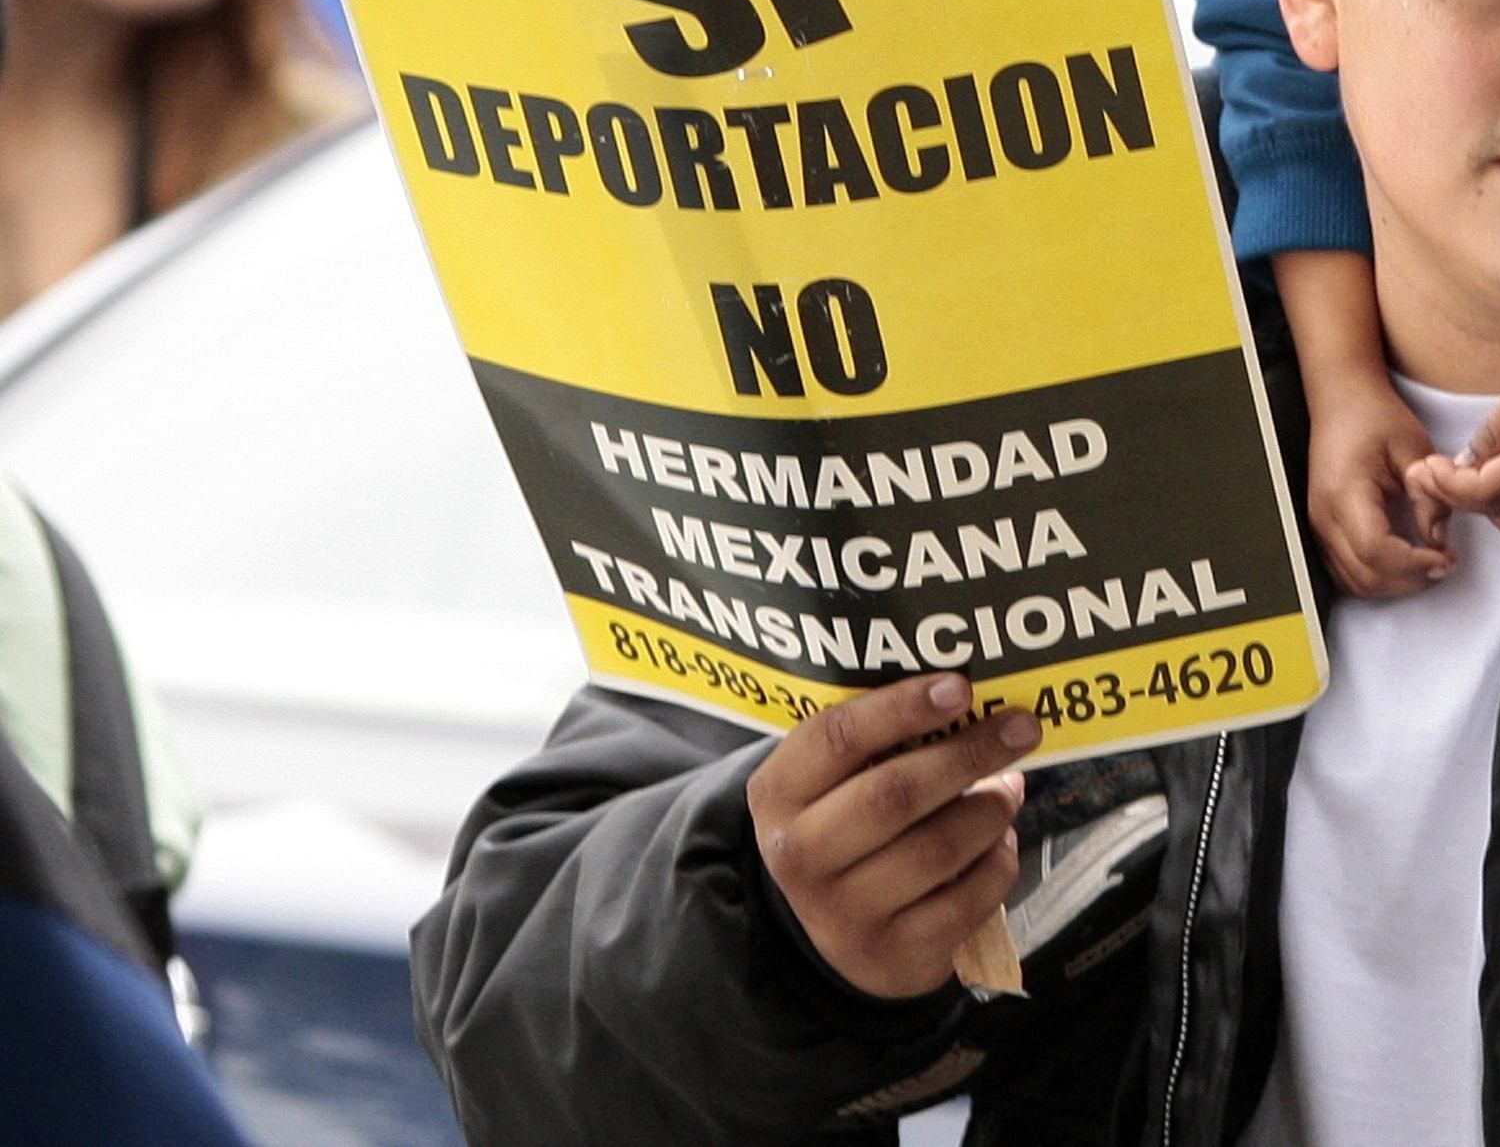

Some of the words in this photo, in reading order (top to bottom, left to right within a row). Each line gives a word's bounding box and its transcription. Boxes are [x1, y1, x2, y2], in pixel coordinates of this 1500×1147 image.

[399, 44, 1156, 212] DEPORTACION
[708, 277, 889, 398] NO
[590, 418, 1109, 509] HERMANDAD
[650, 506, 1088, 591] MEXICANA
[570, 538, 1248, 671] TRANSNACIONAL
[609, 621, 822, 721] 818-989-30
